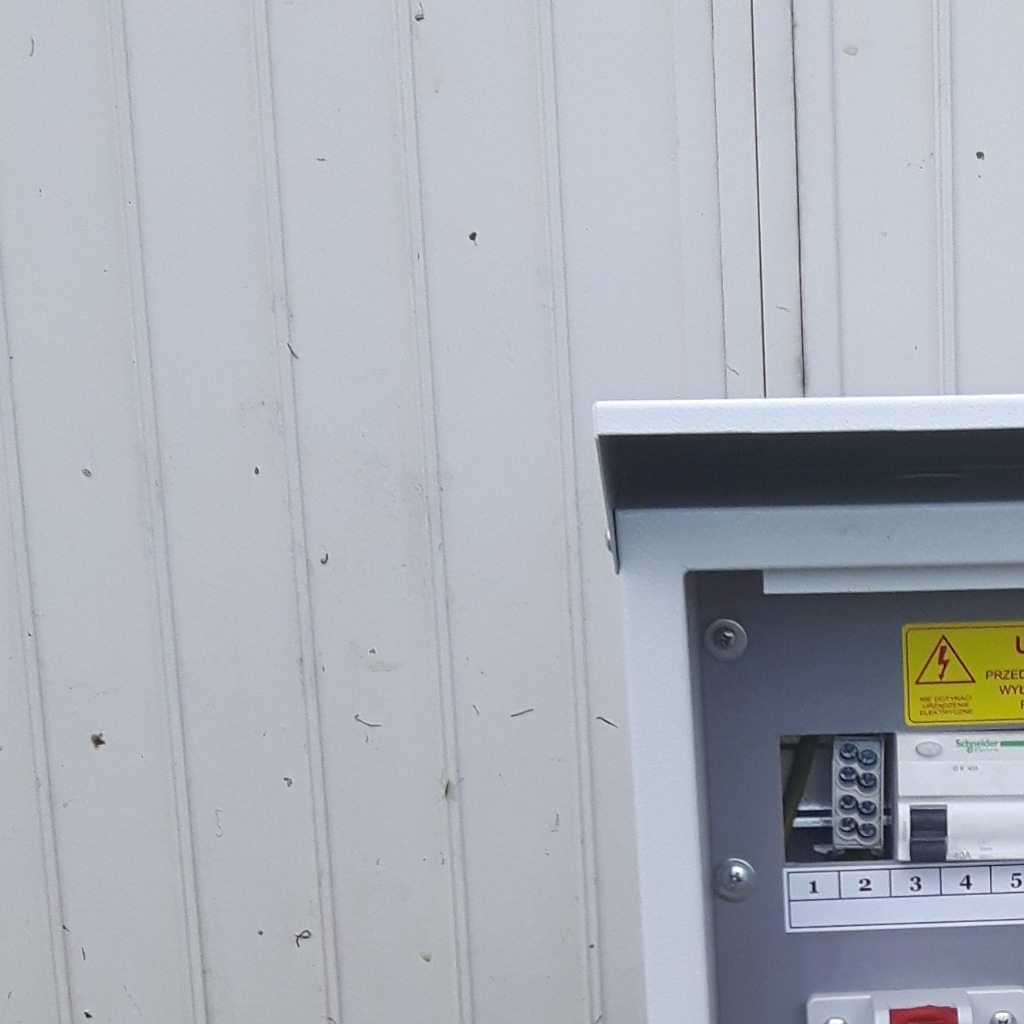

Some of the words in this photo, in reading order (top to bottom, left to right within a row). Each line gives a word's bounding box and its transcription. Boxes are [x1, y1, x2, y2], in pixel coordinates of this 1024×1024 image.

[955, 739, 999, 753] Schneider
[808, 880, 818, 893] 1
[858, 878, 872, 892] 2
[910, 876, 922, 891] 3
[959, 874, 973, 890] 4
[1010, 872, 1023, 888] 5
